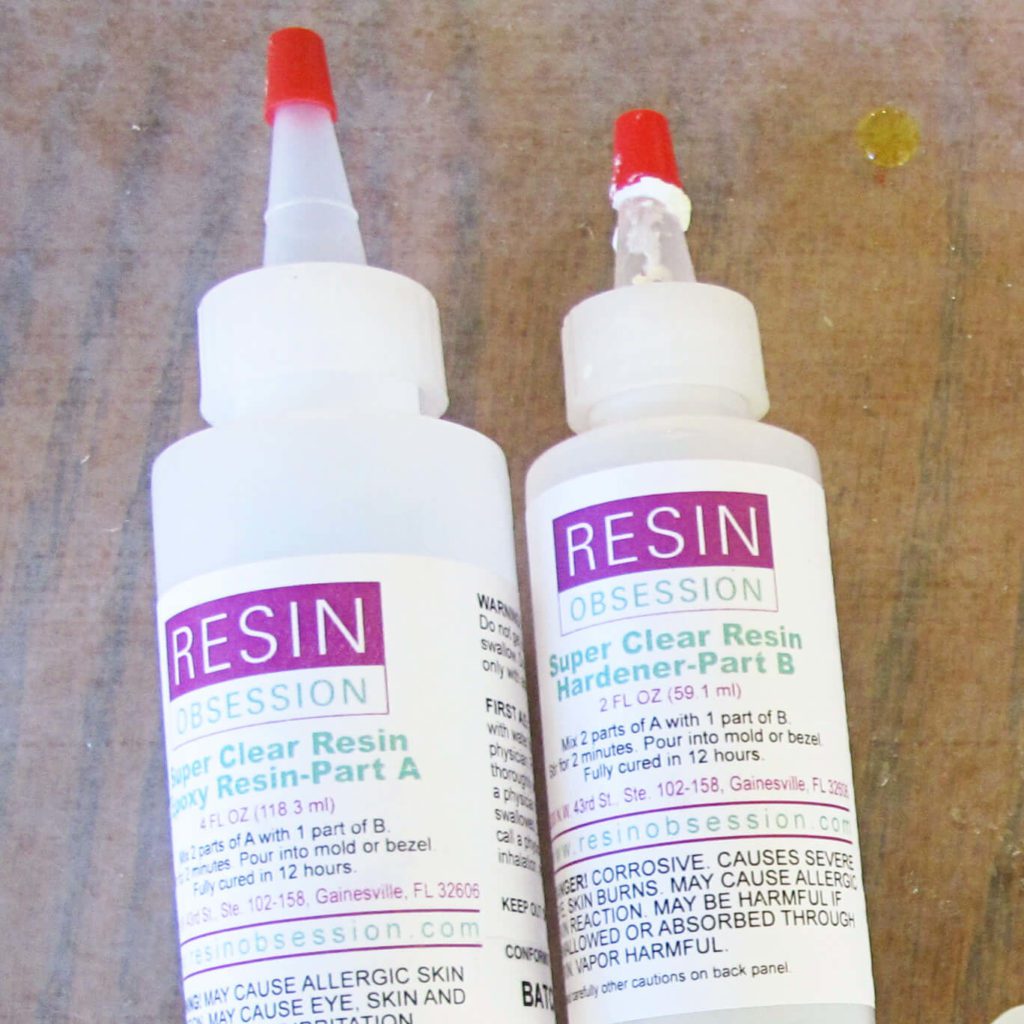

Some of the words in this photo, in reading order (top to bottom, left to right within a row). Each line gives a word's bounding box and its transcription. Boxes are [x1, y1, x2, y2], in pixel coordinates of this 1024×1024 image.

[565, 504, 760, 578] RESIN
[569, 576, 763, 622] OBSESSION
[479, 613, 496, 633] Do
[172, 598, 367, 686] RESIN
[549, 640, 611, 678] Super
[622, 627, 711, 656] Clear
[722, 623, 803, 651] Resin
[483, 658, 504, 681] only
[557, 651, 767, 703] Hardener-Part
[776, 651, 796, 676] B
[176, 677, 368, 735] OBSESSION
[485, 697, 517, 720] FIRST
[599, 697, 608, 712] 2
[613, 693, 632, 709] FL
[636, 689, 661, 706] OZ
[716, 682, 743, 700] ml)
[581, 730, 588, 746] 2
[591, 724, 626, 744] parts
[631, 717, 646, 734] of
[649, 716, 662, 731] A
[665, 712, 700, 729] with
[706, 711, 714, 725] 1
[721, 711, 754, 728] part
[757, 709, 772, 725] of
[219, 739, 300, 768] Clear
[312, 730, 408, 756] Resin
[572, 752, 579, 767] 2
[644, 735, 682, 751] Pour
[689, 731, 719, 745] into
[724, 729, 763, 743] mold
[769, 731, 783, 743] or
[584, 763, 614, 783] Fully
[618, 754, 662, 774] cured
[667, 752, 682, 766] in
[689, 749, 708, 765] 12
[714, 748, 765, 762] hours.
[216, 758, 385, 799] Resin-Part
[396, 757, 421, 781] A
[493, 787, 500, 799] a
[574, 796, 596, 815] 43rd
[657, 776, 724, 798] 102-158,
[812, 776, 826, 794] FL
[210, 813, 224, 827] FL
[228, 807, 249, 825] OZ
[308, 797, 336, 815] ml)
[199, 839, 226, 858] parts
[229, 832, 242, 850] of
[244, 831, 256, 847] A
[259, 827, 291, 844] with
[297, 825, 305, 839] 1
[312, 822, 346, 840] part
[350, 820, 367, 836] of
[240, 850, 274, 867] Pour
[280, 845, 309, 861] into
[315, 840, 357, 856] mold
[363, 842, 380, 857] or
[219, 873, 255, 891] cured
[260, 870, 273, 882] in
[280, 864, 298, 880] 12
[303, 862, 358, 878] hours.
[592, 853, 710, 886] CORROSIVE.
[717, 849, 800, 868] CAUSES
[804, 849, 854, 871] SEVERE
[315, 884, 408, 904] Gainesville,
[413, 882, 434, 900] FL
[437, 881, 480, 899] 32606
[502, 897, 529, 914] KEEP
[568, 891, 593, 914] SKIN
[597, 880, 664, 907] BURNS.
[671, 873, 714, 893] MAY
[721, 869, 791, 888] CAUSE
[796, 869, 858, 891] ALLERGIC
[570, 902, 648, 933] REACTION.
[654, 895, 697, 916] MAY
[704, 892, 732, 911] BE
[738, 889, 828, 908] HARMFUL
[832, 890, 842, 907] IF
[625, 921, 654, 942] OR
[658, 910, 776, 937] ABSORBED
[780, 909, 856, 928] THROUGH
[576, 949, 621, 974] VAPOR
[625, 936, 729, 964] HARMFUL.
[204, 986, 230, 1006] MAY
[234, 976, 297, 1001] CAUSE
[302, 967, 410, 993] ALLERGIC
[417, 965, 465, 983] SKIN
[601, 979, 628, 994] other
[631, 971, 686, 989] cautions
[690, 968, 709, 982] on
[712, 964, 748, 979] back
[240, 998, 304, 1023] CAUSE
[367, 990, 419, 1010] SKIN
[424, 988, 467, 1006] AND
